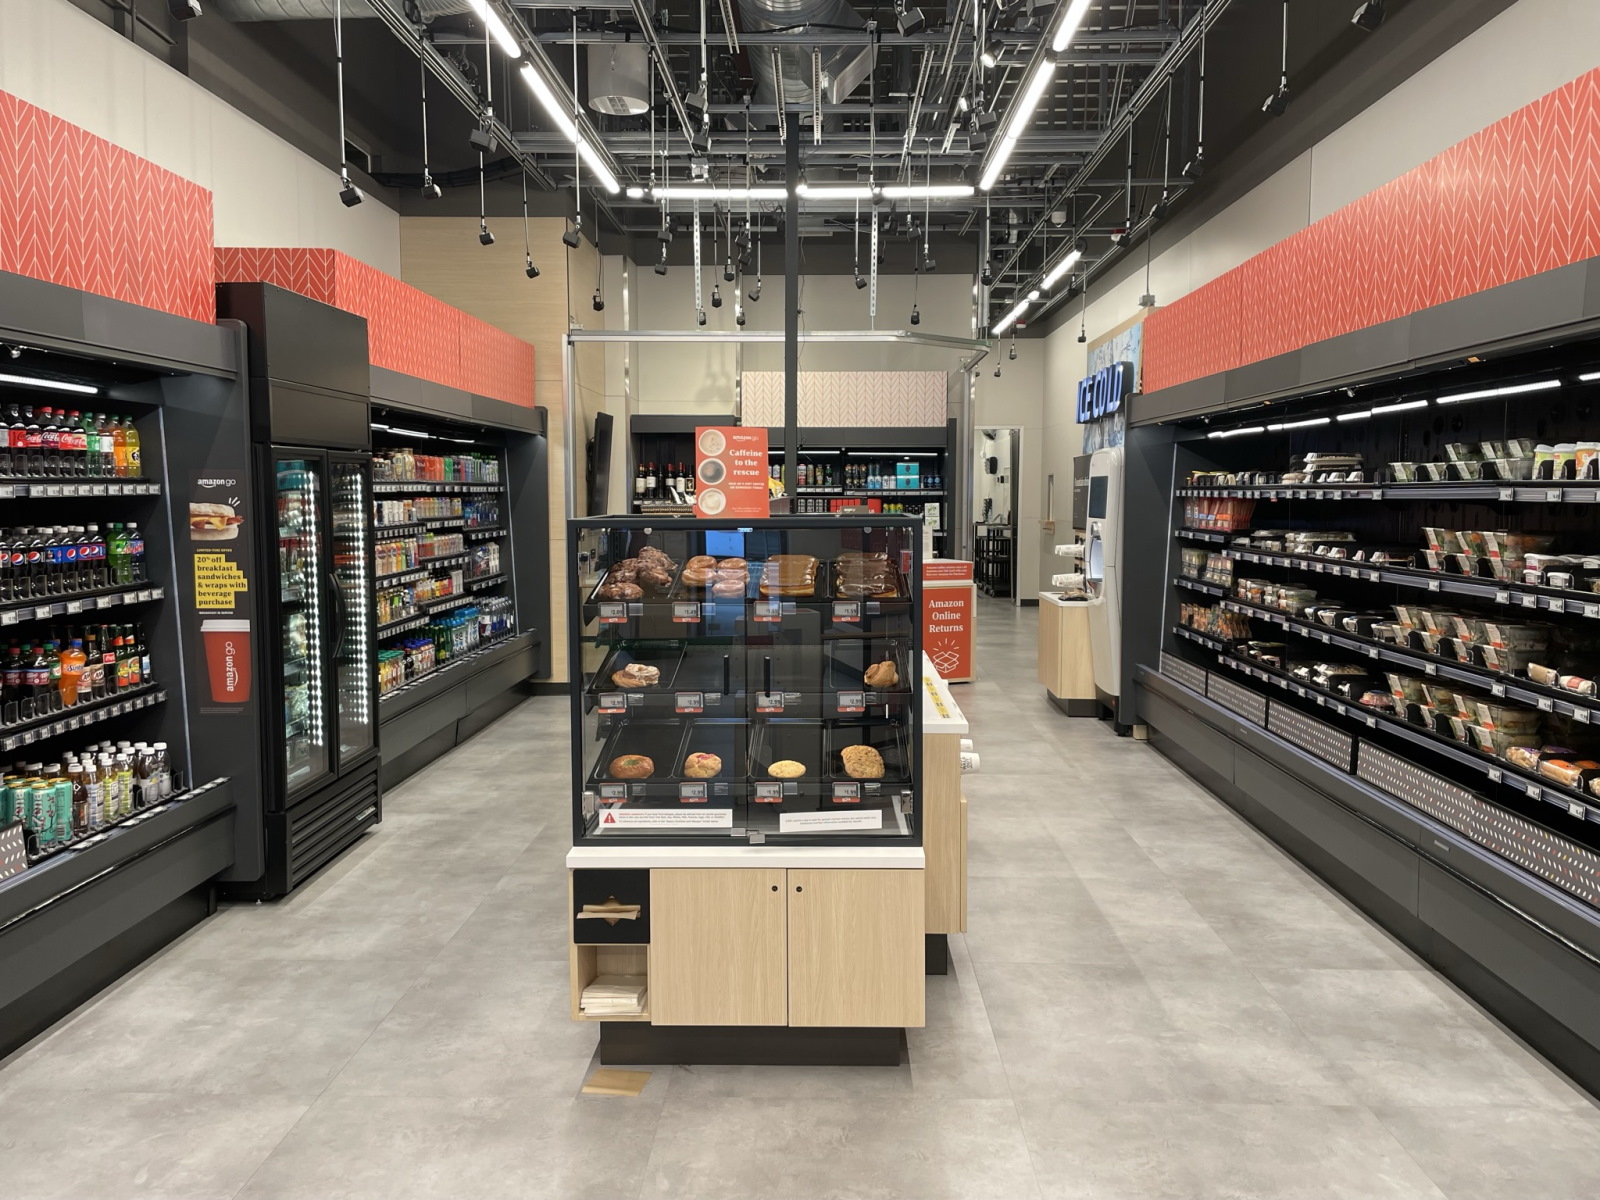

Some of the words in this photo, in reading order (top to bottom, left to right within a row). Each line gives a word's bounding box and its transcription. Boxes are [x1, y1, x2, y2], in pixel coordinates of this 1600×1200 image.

[1076, 376, 1092, 424] ICE
[1093, 361, 1123, 418] COLD
[729, 449, 763, 457] Caffeine
[733, 468, 760, 476] rescue
[197, 479, 225, 488] amazon
[226, 479, 236, 487] go
[928, 599, 964, 609] Amazon
[932, 611, 961, 620] Online
[929, 624, 964, 633] Returns
[225, 641, 236, 655] go
[226, 656, 236, 692] amazon
